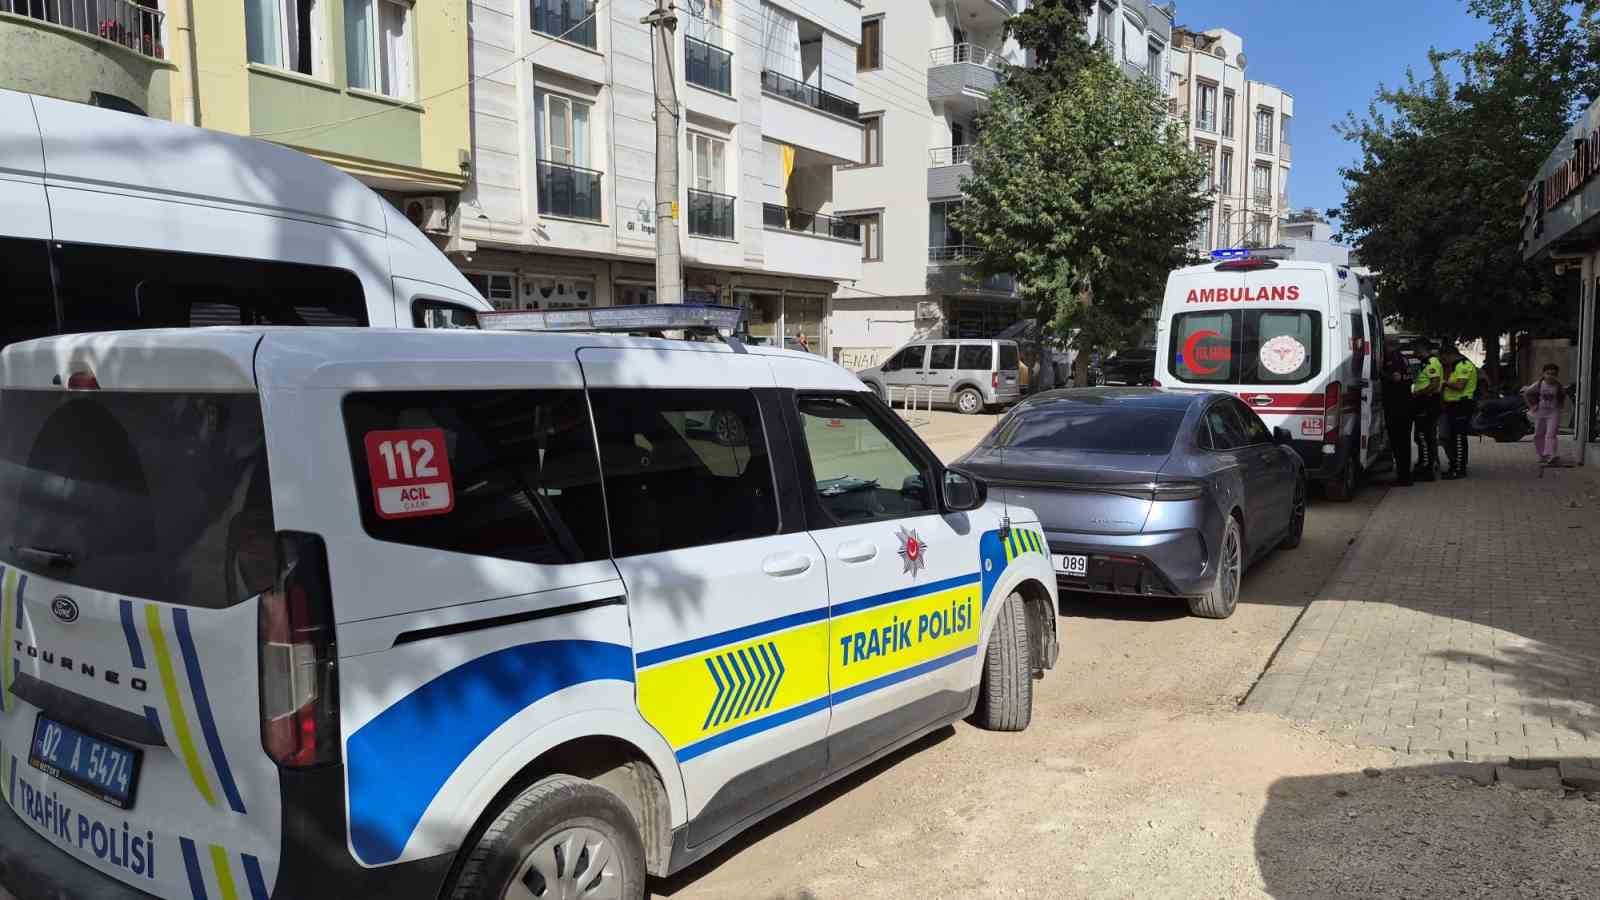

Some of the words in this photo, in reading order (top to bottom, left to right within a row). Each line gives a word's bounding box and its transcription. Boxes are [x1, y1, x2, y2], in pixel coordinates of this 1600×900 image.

[1186, 285, 1300, 304] AMBULANS
[379, 438, 439, 480] 112
[1063, 556, 1085, 571] 089
[840, 615, 912, 667] TRAFİK
[918, 597, 972, 643] POLİSİ
[14, 640, 147, 692] TOURNEO
[42, 724, 63, 763] 02
[70, 736, 83, 773] A
[88, 743, 128, 793] 5474
[19, 777, 72, 843] TRAFİK
[77, 812, 154, 879] POLİSİ
